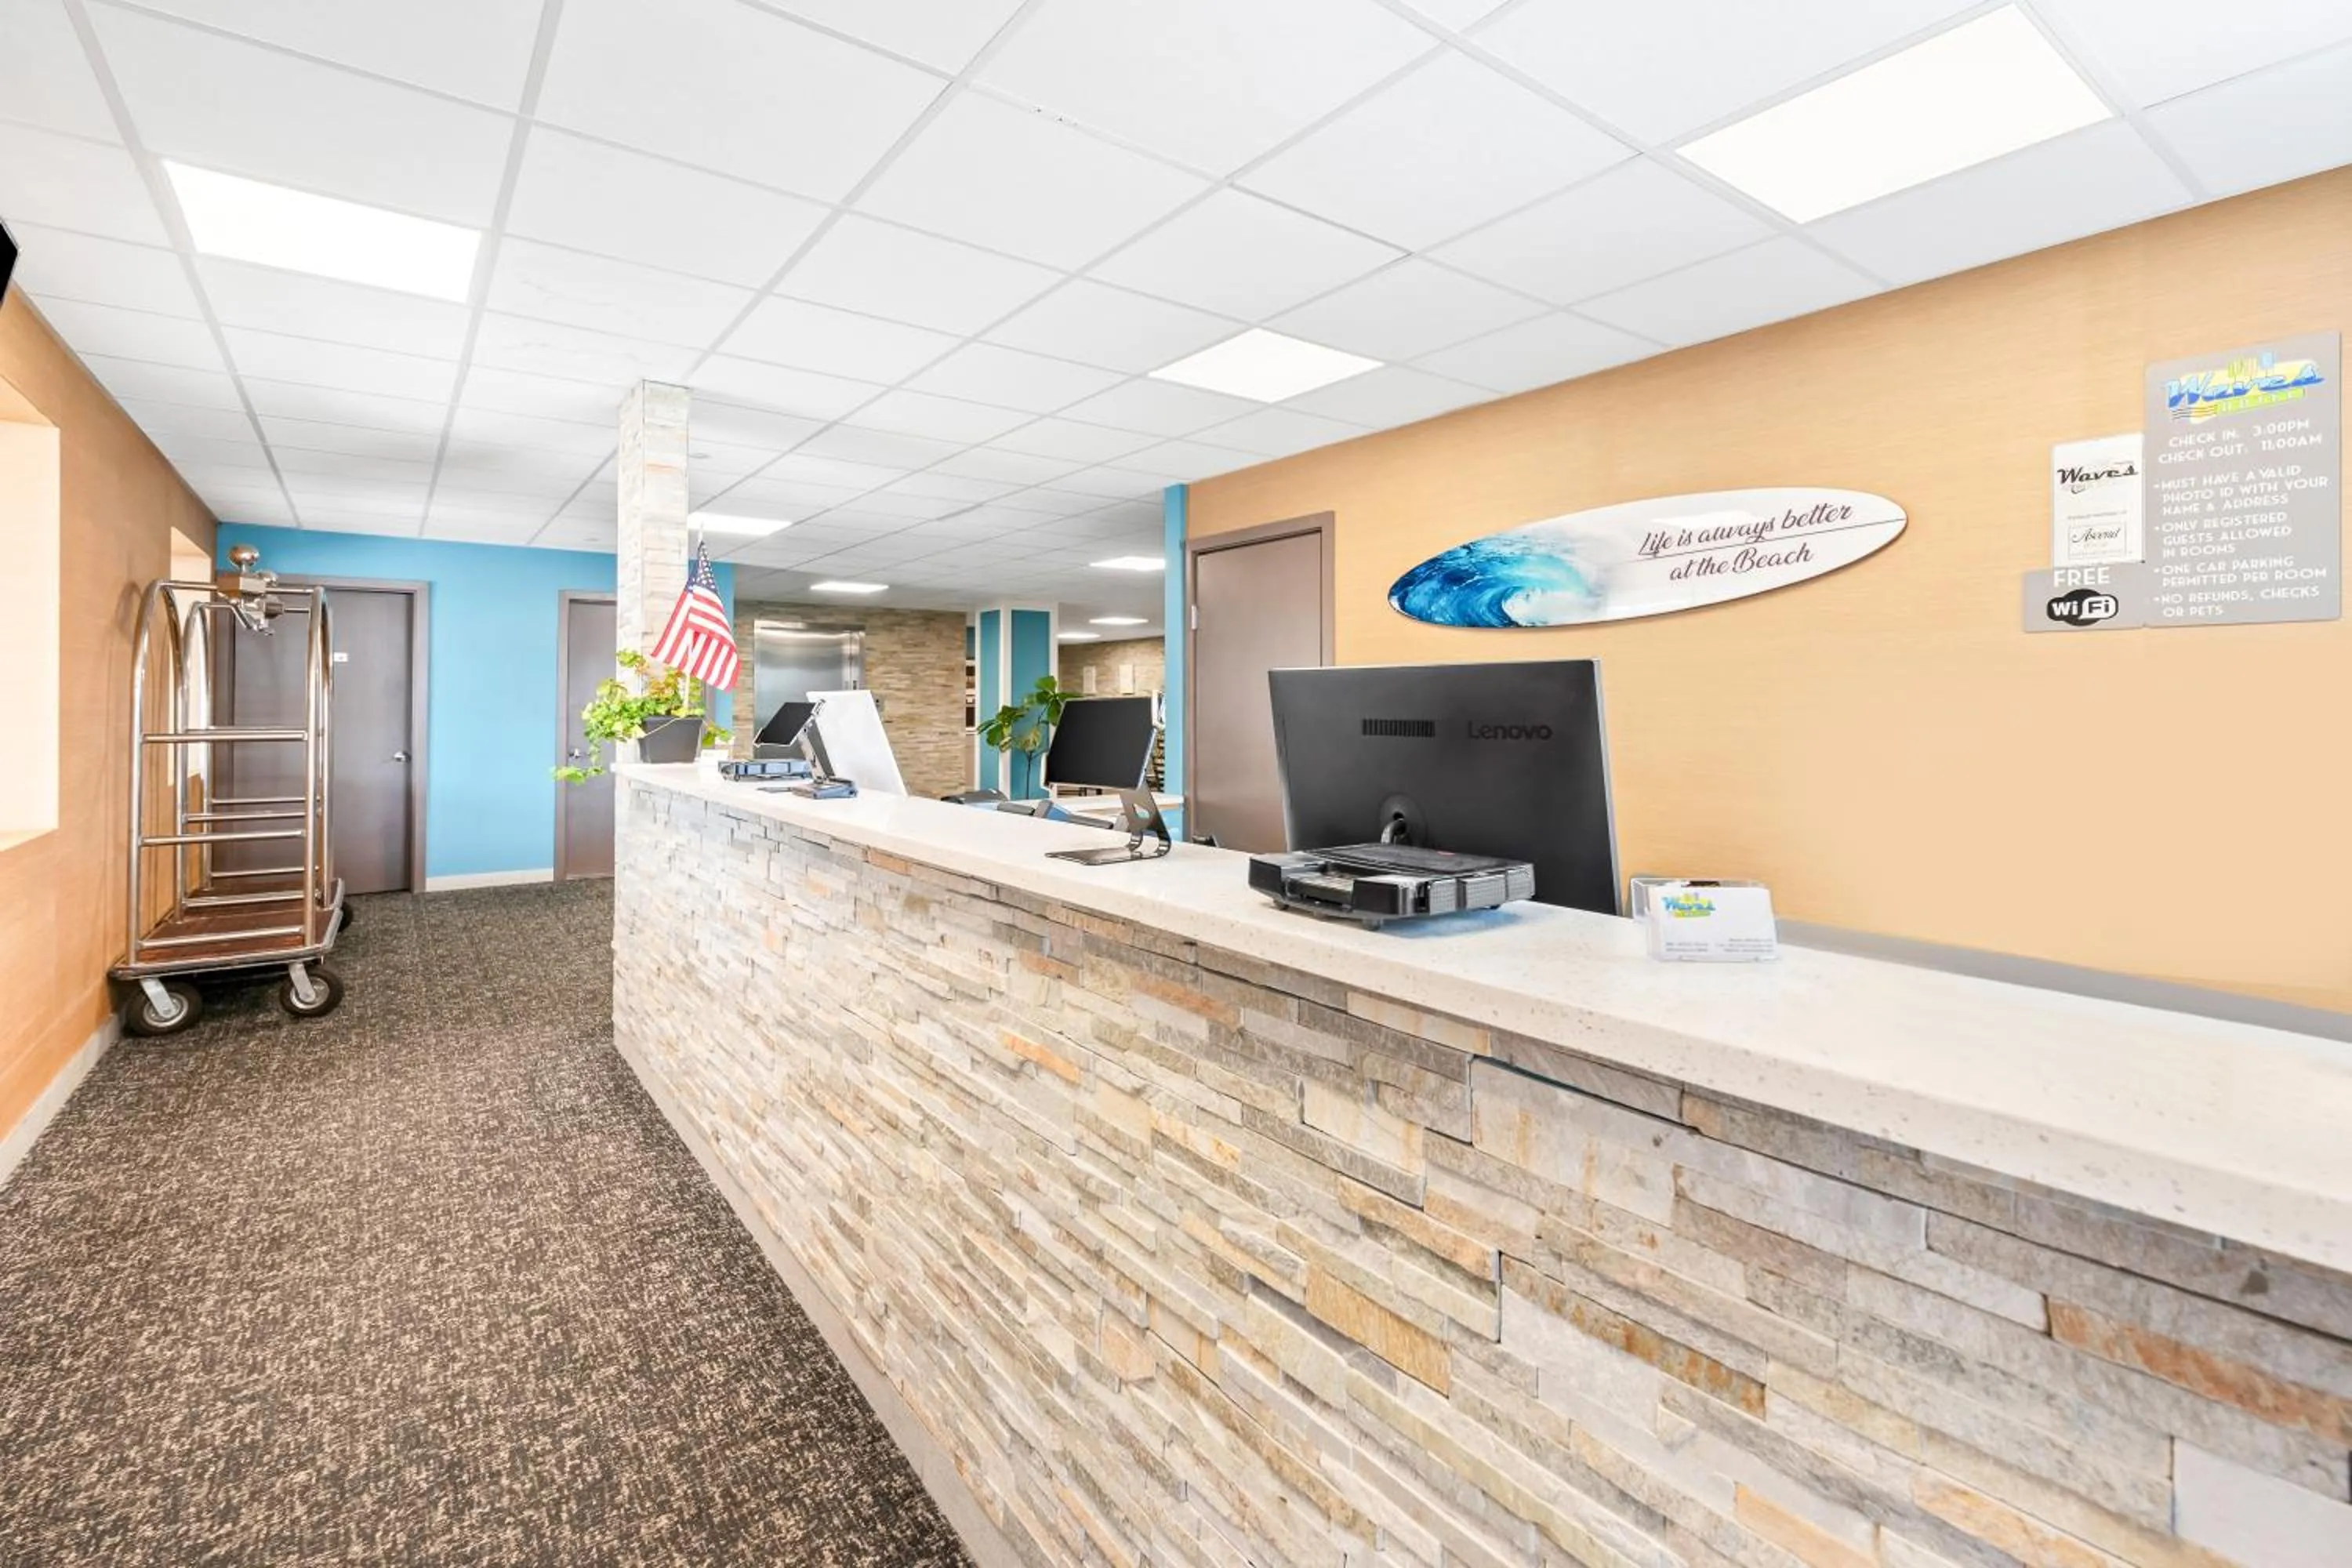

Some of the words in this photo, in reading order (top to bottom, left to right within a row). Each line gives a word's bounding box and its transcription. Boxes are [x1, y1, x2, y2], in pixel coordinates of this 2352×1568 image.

[2162, 363, 2326, 408] Waves
[2169, 431, 2216, 448] CHECK
[2158, 448, 2205, 464] CHECK
[2056, 464, 2139, 485] Waves
[2161, 477, 2195, 490] MUST
[2202, 472, 2239, 486] HAVE
[2245, 470, 2256, 481] A
[2259, 465, 2302, 479] VALID
[2163, 489, 2213, 503] PHOTO
[2220, 487, 2234, 498] ID
[2239, 482, 2278, 495] WITH
[2285, 476, 2328, 491] YOUR
[2163, 503, 2201, 516] NAME
[2223, 493, 2288, 511] ADDRESS
[1638, 532, 1673, 558] Life
[1677, 528, 1693, 547] is
[1698, 517, 1776, 544] always
[1780, 503, 1853, 529] better
[2161, 521, 2198, 532] ONLY
[2204, 512, 2287, 529] REGISTERED
[2163, 533, 2213, 546] GUESTS
[2220, 525, 2292, 541] ALLOWED
[2163, 548, 2176, 558] IN
[2180, 543, 2237, 557] ROOMS
[1669, 558, 1695, 581] at
[1696, 556, 1730, 578] the
[1731, 542, 1813, 574] Beach
[2161, 564, 2190, 575] ONE
[2196, 561, 2226, 573] CAR
[2232, 556, 2294, 571] PARKING
[2053, 566, 2111, 588] FREE
[2162, 574, 2237, 587] PERMITTED
[2243, 572, 2268, 583] PER
[2274, 568, 2327, 580] ROOM
[2161, 593, 2183, 604] NO
[2259, 586, 2321, 599] CHECKS
[2163, 607, 2183, 617] OR
[2190, 605, 2223, 616] PETS
[1467, 720, 1553, 740] Lenovo
